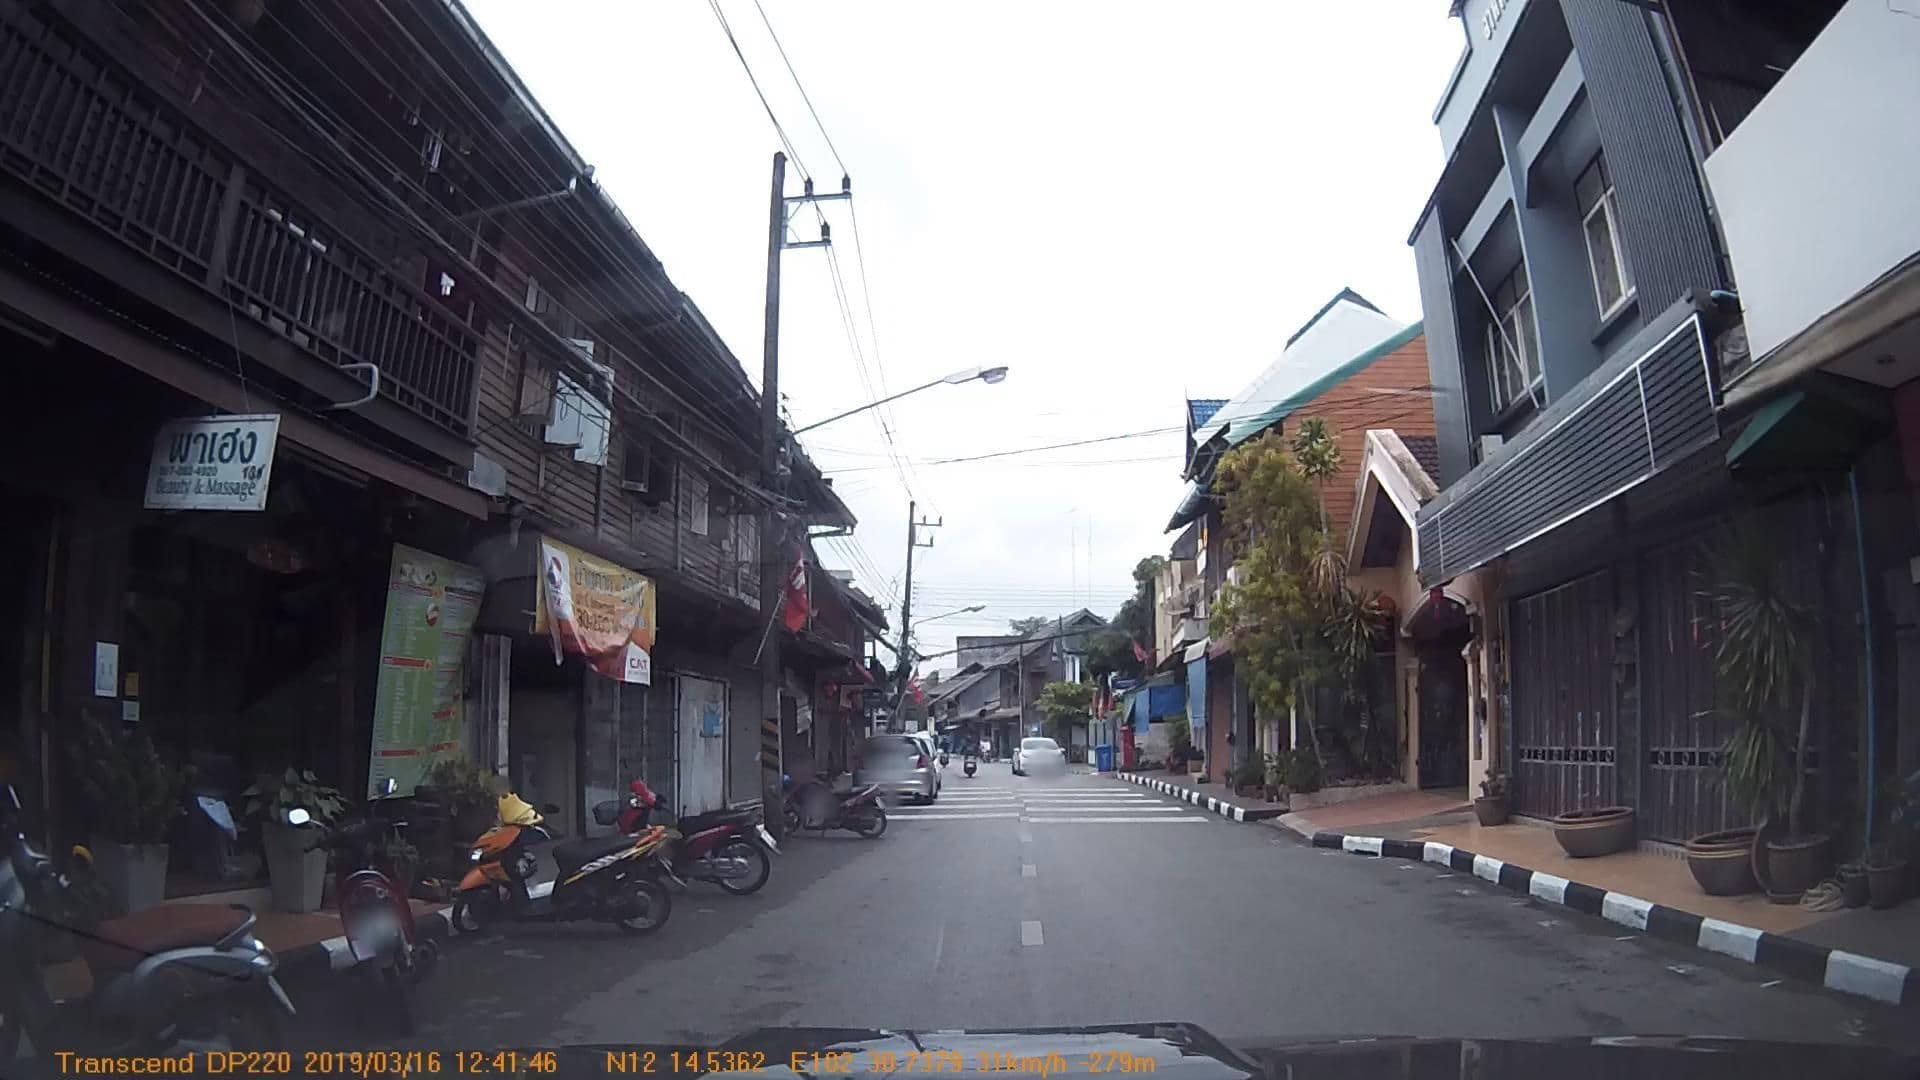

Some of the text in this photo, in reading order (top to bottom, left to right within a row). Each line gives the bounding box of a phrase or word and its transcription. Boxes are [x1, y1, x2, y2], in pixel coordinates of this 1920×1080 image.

[169, 428, 257, 464] พาเฮง
[194, 478, 205, 495] &
[206, 478, 256, 502] Massage
[630, 658, 647, 670] CAT
